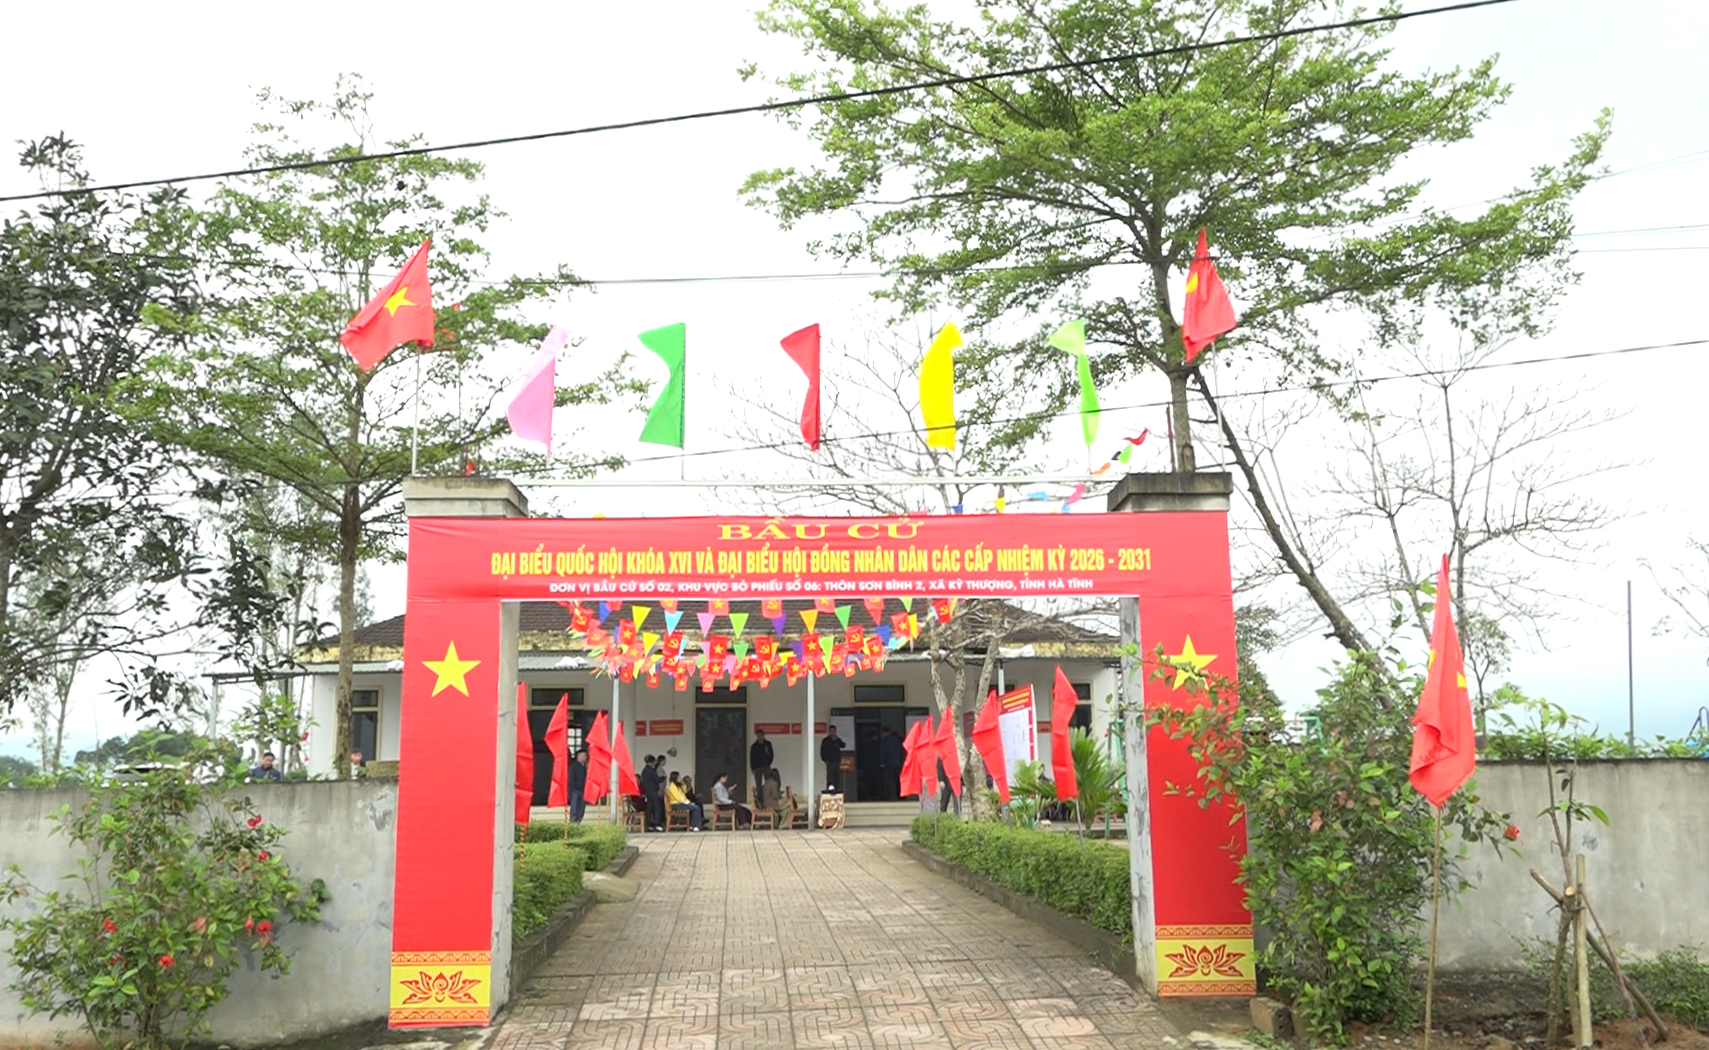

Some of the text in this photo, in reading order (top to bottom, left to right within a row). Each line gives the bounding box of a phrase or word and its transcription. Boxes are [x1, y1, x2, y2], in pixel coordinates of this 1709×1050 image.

[717, 515, 925, 540] BẦU CỬ
[491, 552, 516, 580] ĐẠI
[519, 543, 552, 575] BIỂU
[556, 544, 595, 577] QUỐC
[598, 547, 622, 579] HỘI
[626, 547, 665, 575] KHÓA
[669, 551, 692, 574] XVI
[695, 546, 714, 574] VÀ
[717, 551, 742, 578] ĐẠI
[746, 541, 778, 573] BIỂU
[782, 546, 806, 578] HỘI
[810, 542, 850, 573] ĐỒNG
[854, 545, 894, 572] NHÂN
[898, 545, 928, 572] DÂN
[932, 545, 960, 572] CÁC
[964, 541, 993, 572] CẤP
[997, 544, 1044, 576] NHIỆM
[1047, 543, 1066, 571] KỲ
[1070, 548, 1104, 571] 2026
[1118, 548, 1151, 571] 2031
[550, 582, 575, 592] ĐƠN
[579, 583, 590, 594] VỊ
[619, 580, 637, 592] CỬ
[639, 579, 655, 592] SỐ
[657, 582, 674, 593] 02,
[678, 582, 701, 592] KHU
[704, 581, 728, 593] VỰC
[732, 579, 748, 592] BỎ
[751, 578, 783, 591] PHIẾU
[786, 578, 801, 591] SỐ
[804, 581, 822, 592] 06:
[824, 579, 855, 591] THÔN
[859, 579, 882, 591] SƠN
[886, 578, 912, 590] BÌNH
[915, 581, 926, 591] 2,
[929, 578, 945, 590] XÃ
[966, 579, 1017, 592] THƯỢNG,
[1020, 577, 1045, 589] TỈNH
[1048, 577, 1065, 589] HÀ
[1067, 577, 1093, 589] TĨNH
